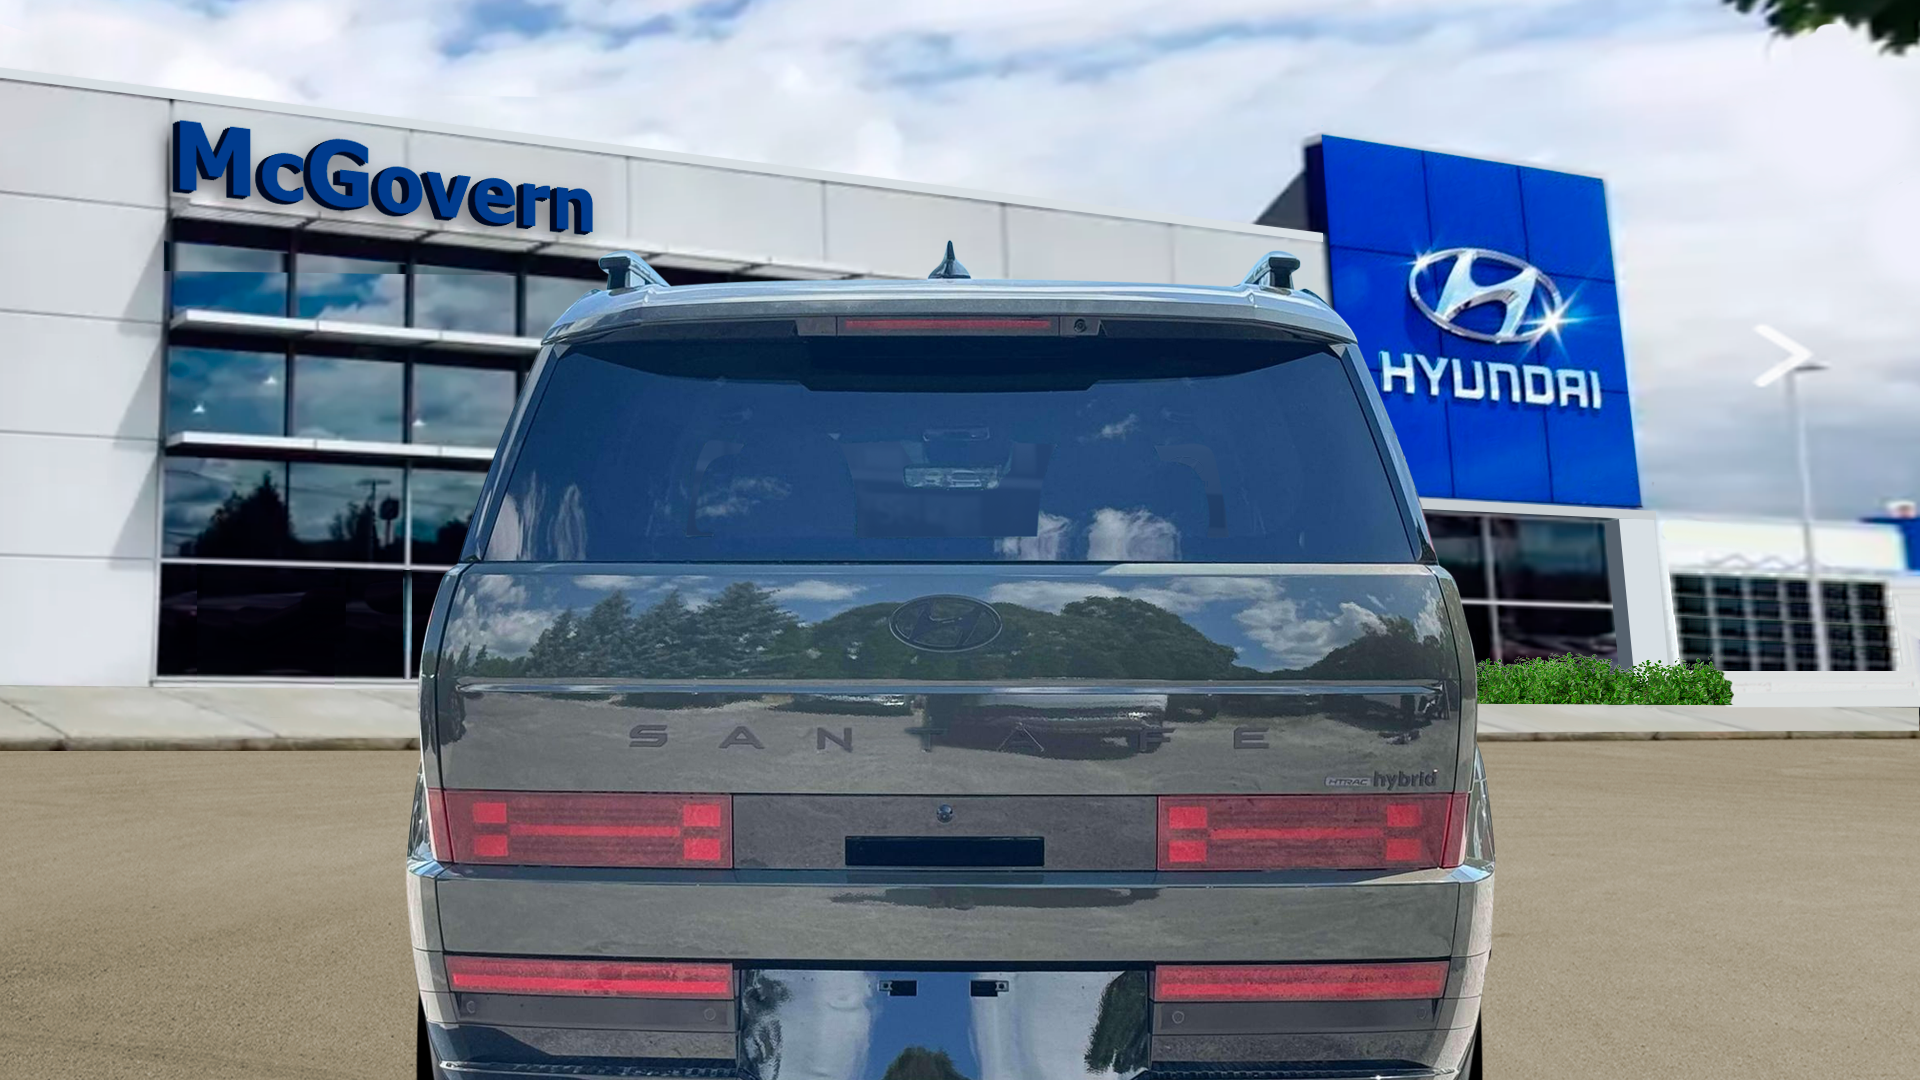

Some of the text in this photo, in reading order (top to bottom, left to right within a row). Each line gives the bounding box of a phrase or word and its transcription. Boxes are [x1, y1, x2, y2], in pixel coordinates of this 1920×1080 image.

[173, 120, 594, 235] McGovern
[1379, 350, 1602, 409] HYUNDAI
[628, 722, 1271, 752] SANTA FE
[1327, 768, 1438, 791] HTRAC hybrid
